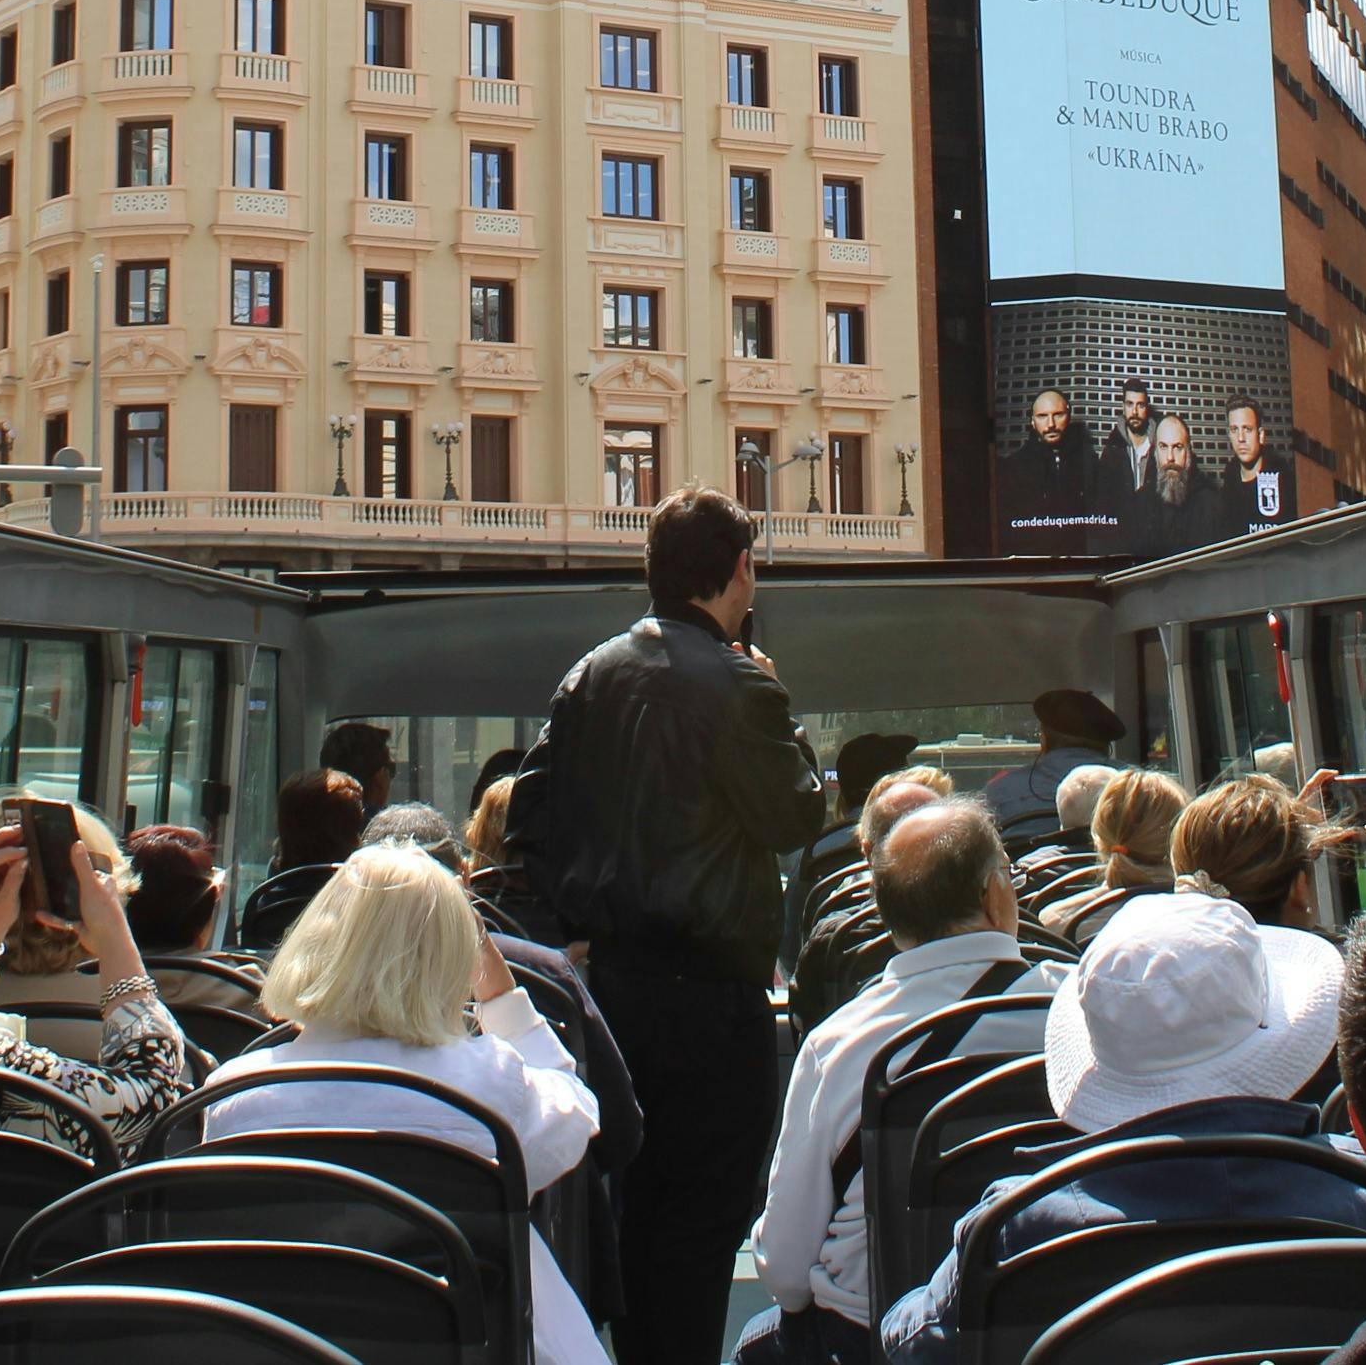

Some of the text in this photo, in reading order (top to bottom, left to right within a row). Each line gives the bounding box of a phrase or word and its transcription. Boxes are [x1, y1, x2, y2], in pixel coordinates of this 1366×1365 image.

[1120, 49, 1162, 65] MÚSICA
[1084, 80, 1196, 112] TOUNDRA
[1056, 105, 1228, 142] & MANU BRABO
[1088, 145, 1204, 175] «UKRAÍNA»
[1011, 514, 1118, 529] condeduquemadrid.es
